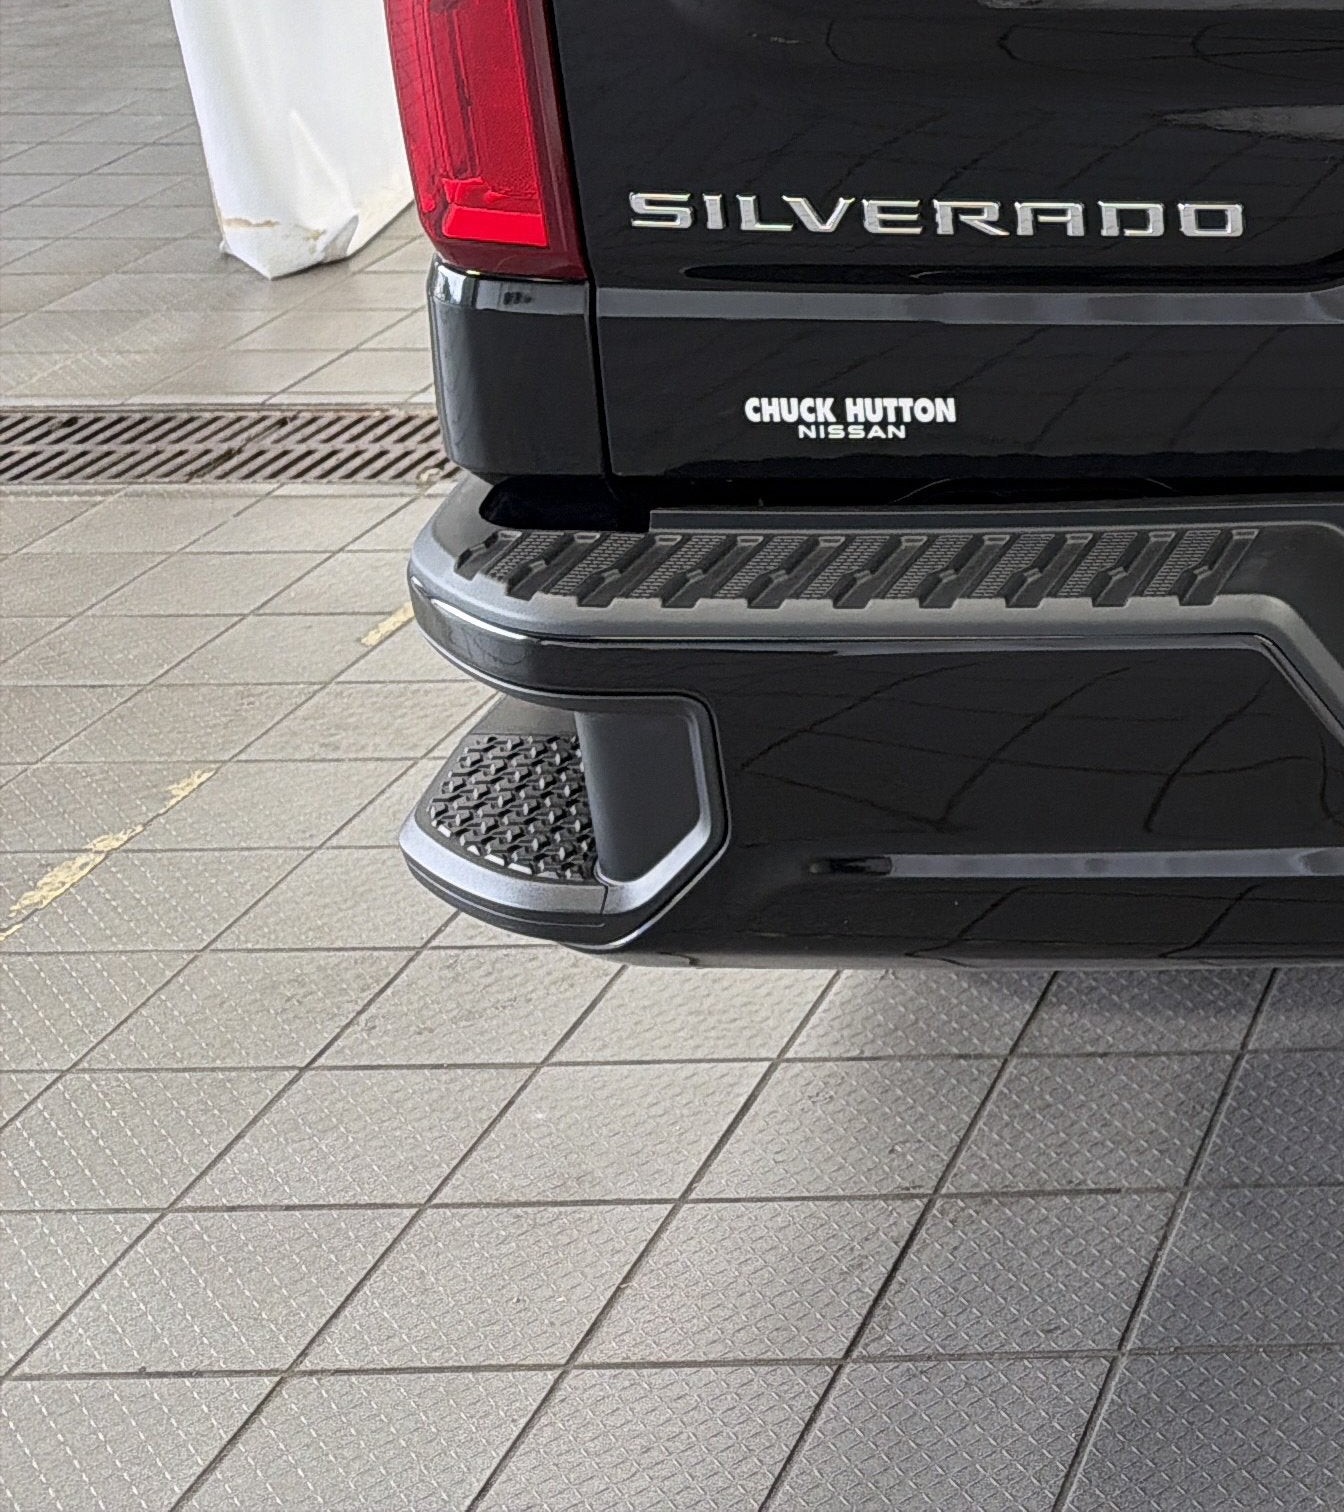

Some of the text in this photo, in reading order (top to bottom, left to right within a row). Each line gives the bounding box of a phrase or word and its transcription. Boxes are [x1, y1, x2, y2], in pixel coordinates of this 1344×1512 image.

[629, 192, 1244, 237] SILVERADO
[744, 397, 956, 423] CHUCK HUTTON
[797, 425, 906, 439] NISSAN
